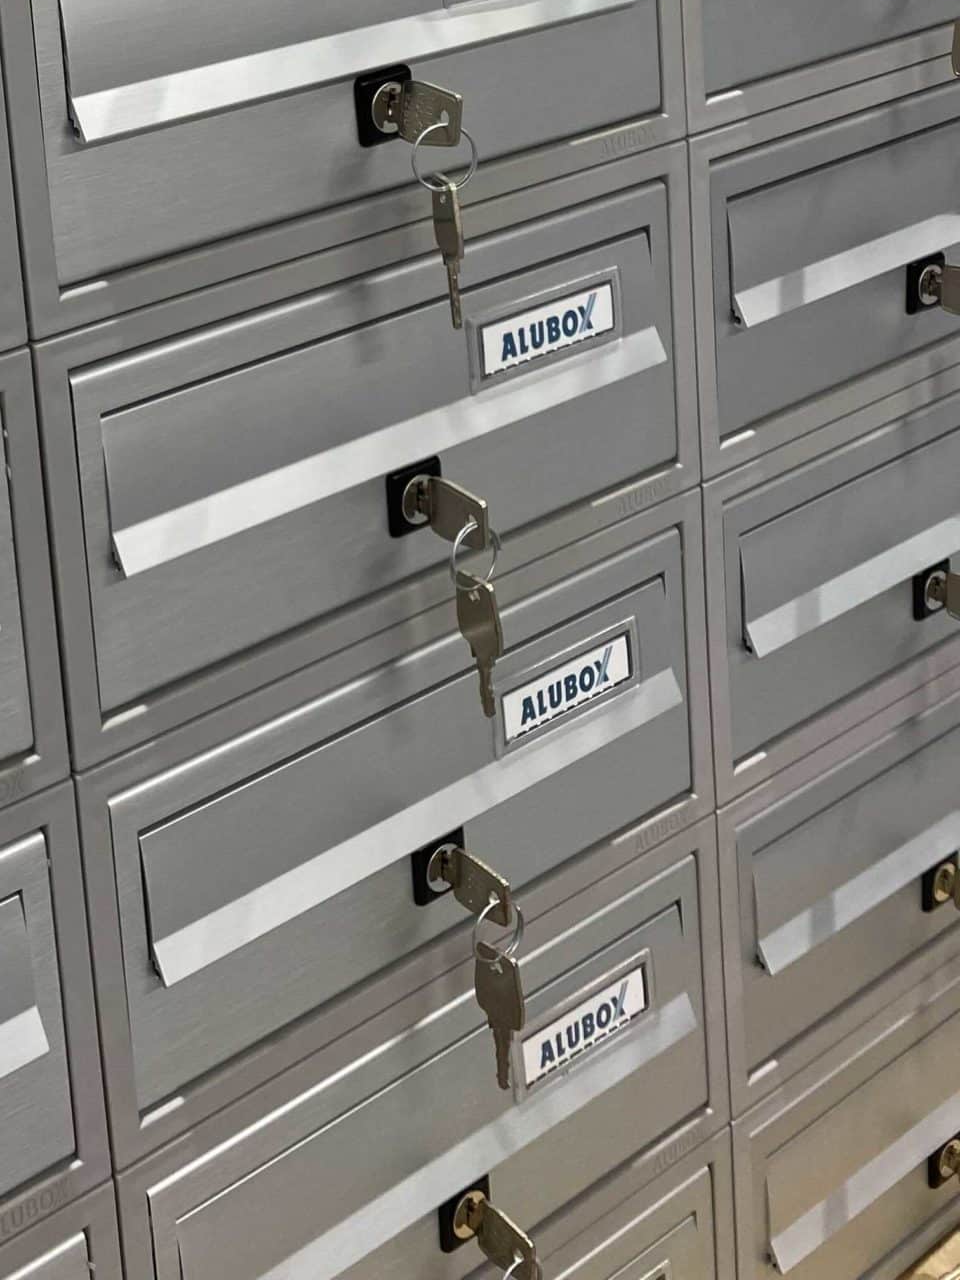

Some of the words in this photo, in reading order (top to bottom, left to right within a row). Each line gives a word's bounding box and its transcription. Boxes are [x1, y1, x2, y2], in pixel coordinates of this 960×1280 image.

[502, 293, 596, 361] ALUBOX
[520, 645, 613, 726] ALUBOX
[540, 980, 627, 1068] ALUBOX
